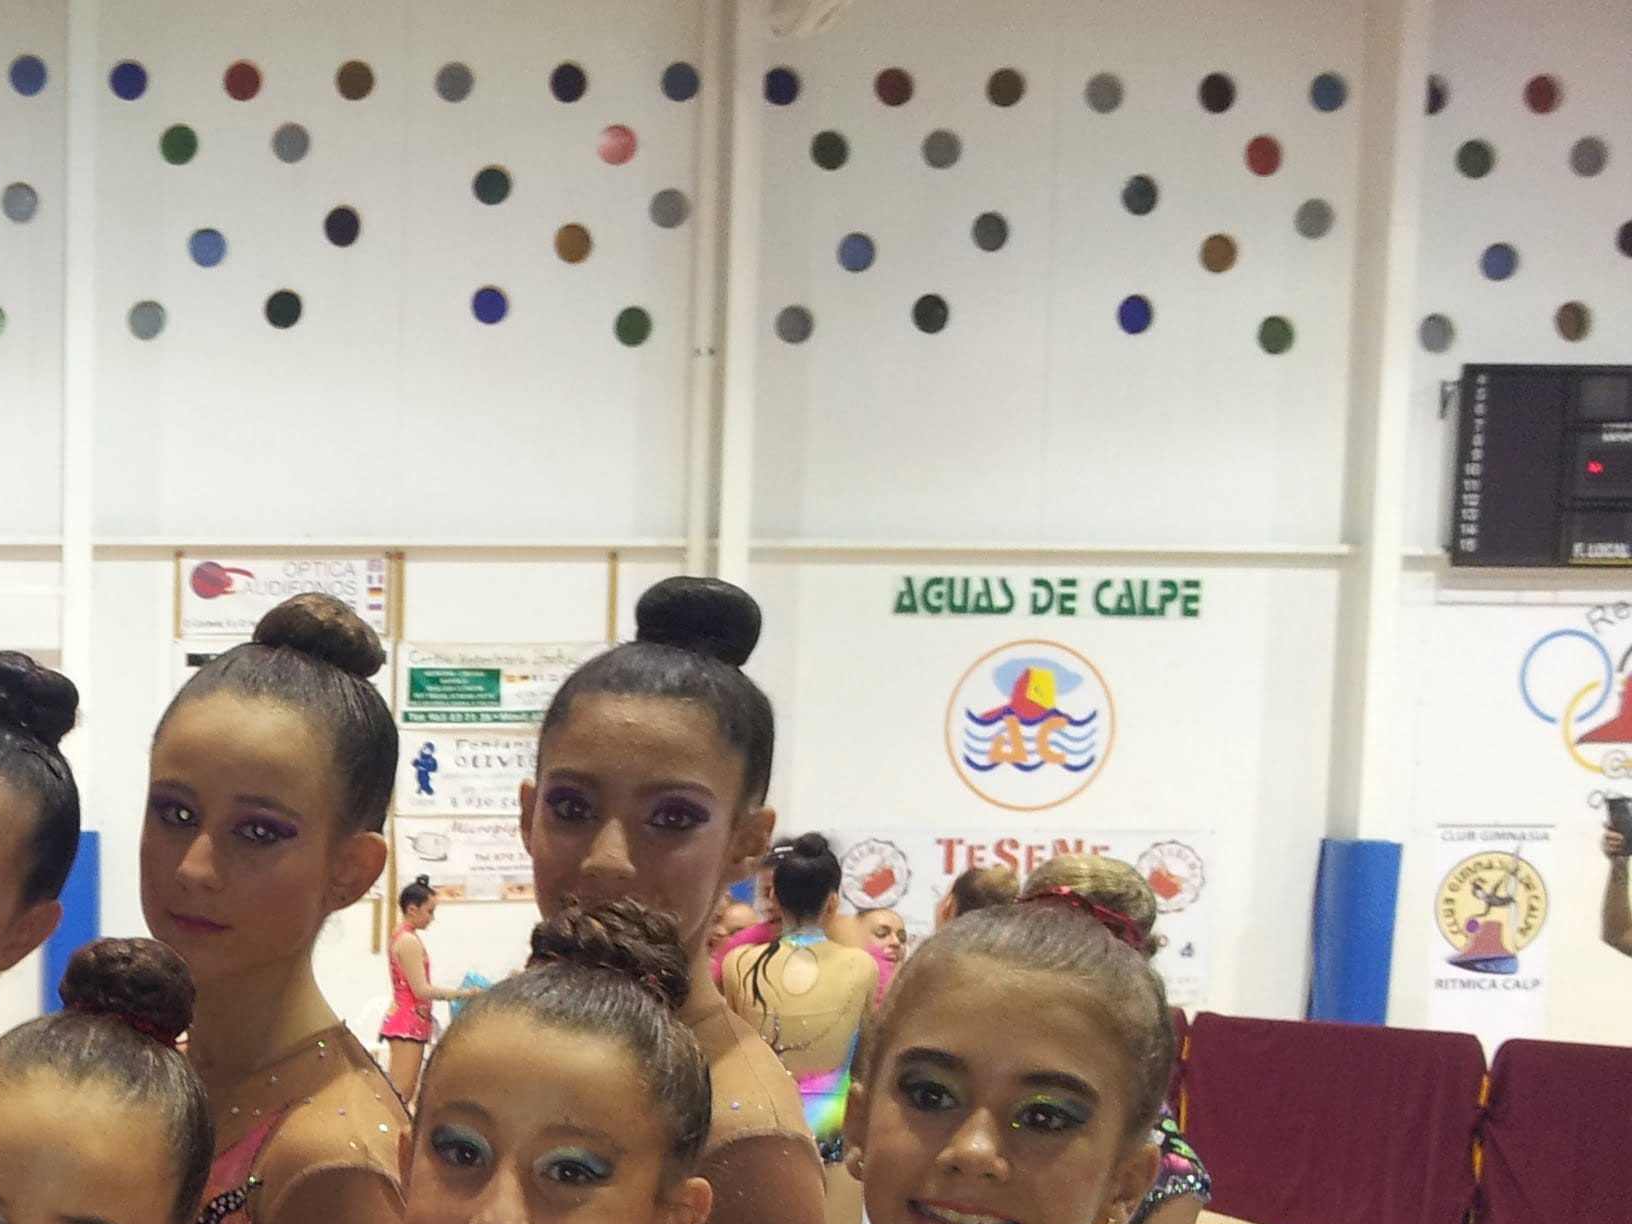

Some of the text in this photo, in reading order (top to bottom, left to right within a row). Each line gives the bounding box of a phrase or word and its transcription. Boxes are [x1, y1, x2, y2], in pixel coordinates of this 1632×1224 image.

[893, 576, 1201, 616] AGUAS DE CALPE
[1441, 831, 1550, 841] CLUB GIMNASIA
